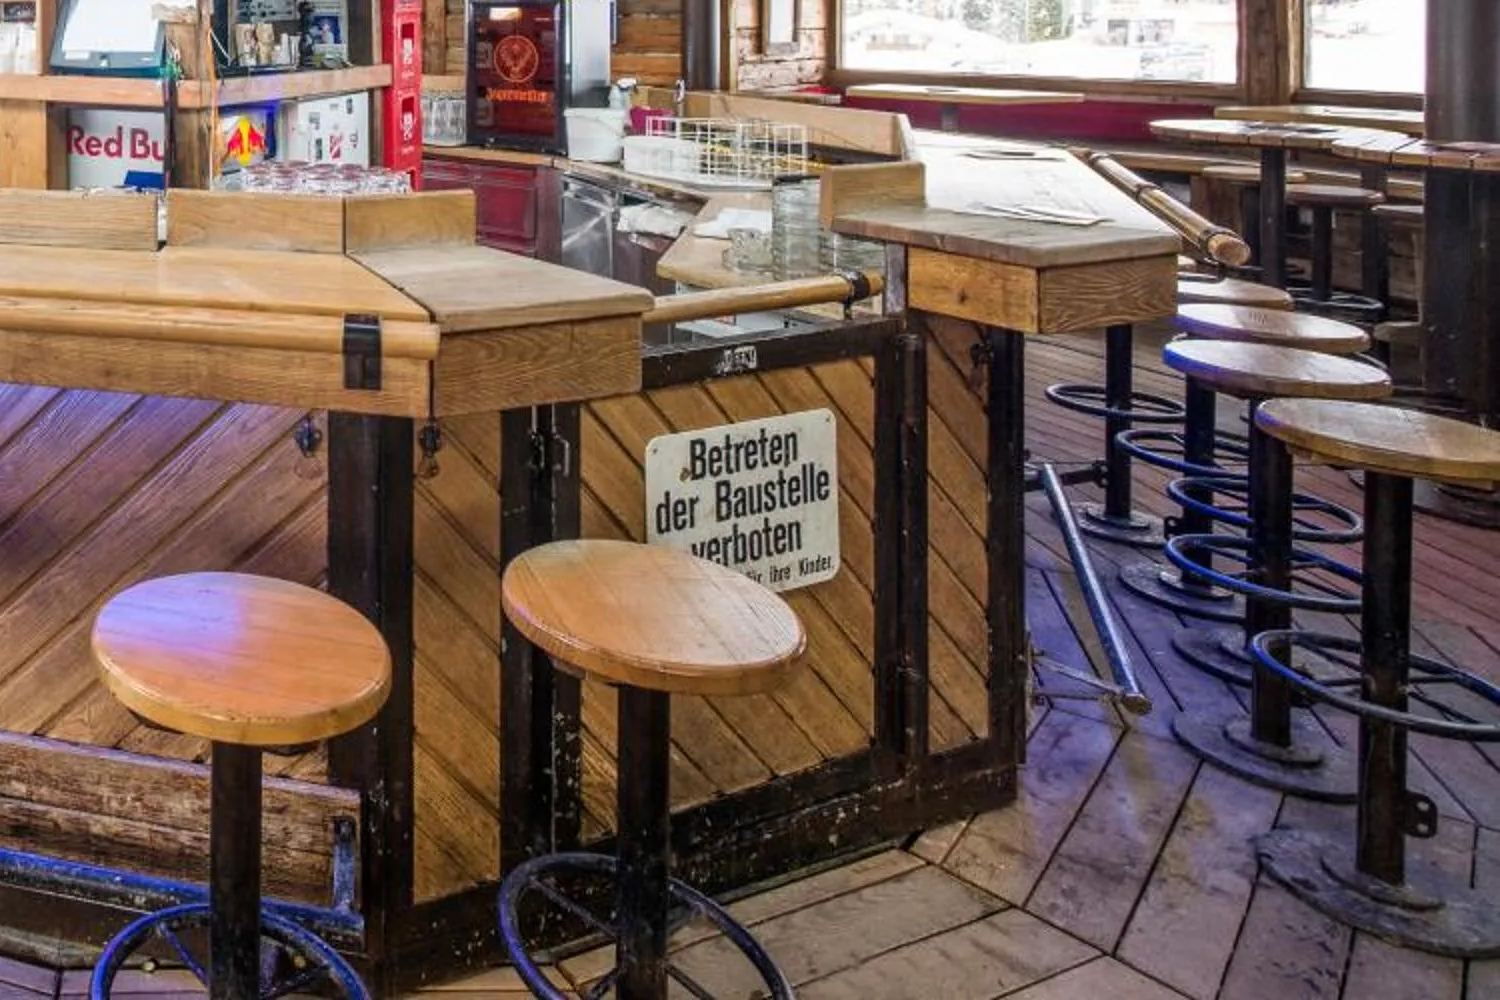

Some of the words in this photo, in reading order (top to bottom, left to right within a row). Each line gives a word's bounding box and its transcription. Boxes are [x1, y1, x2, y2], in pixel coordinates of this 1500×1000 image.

[67, 124, 123, 158] Red
[690, 428, 798, 482] Betreten
[655, 490, 699, 534] der
[715, 462, 830, 522] Baustelle
[769, 565, 791, 583] ihre
